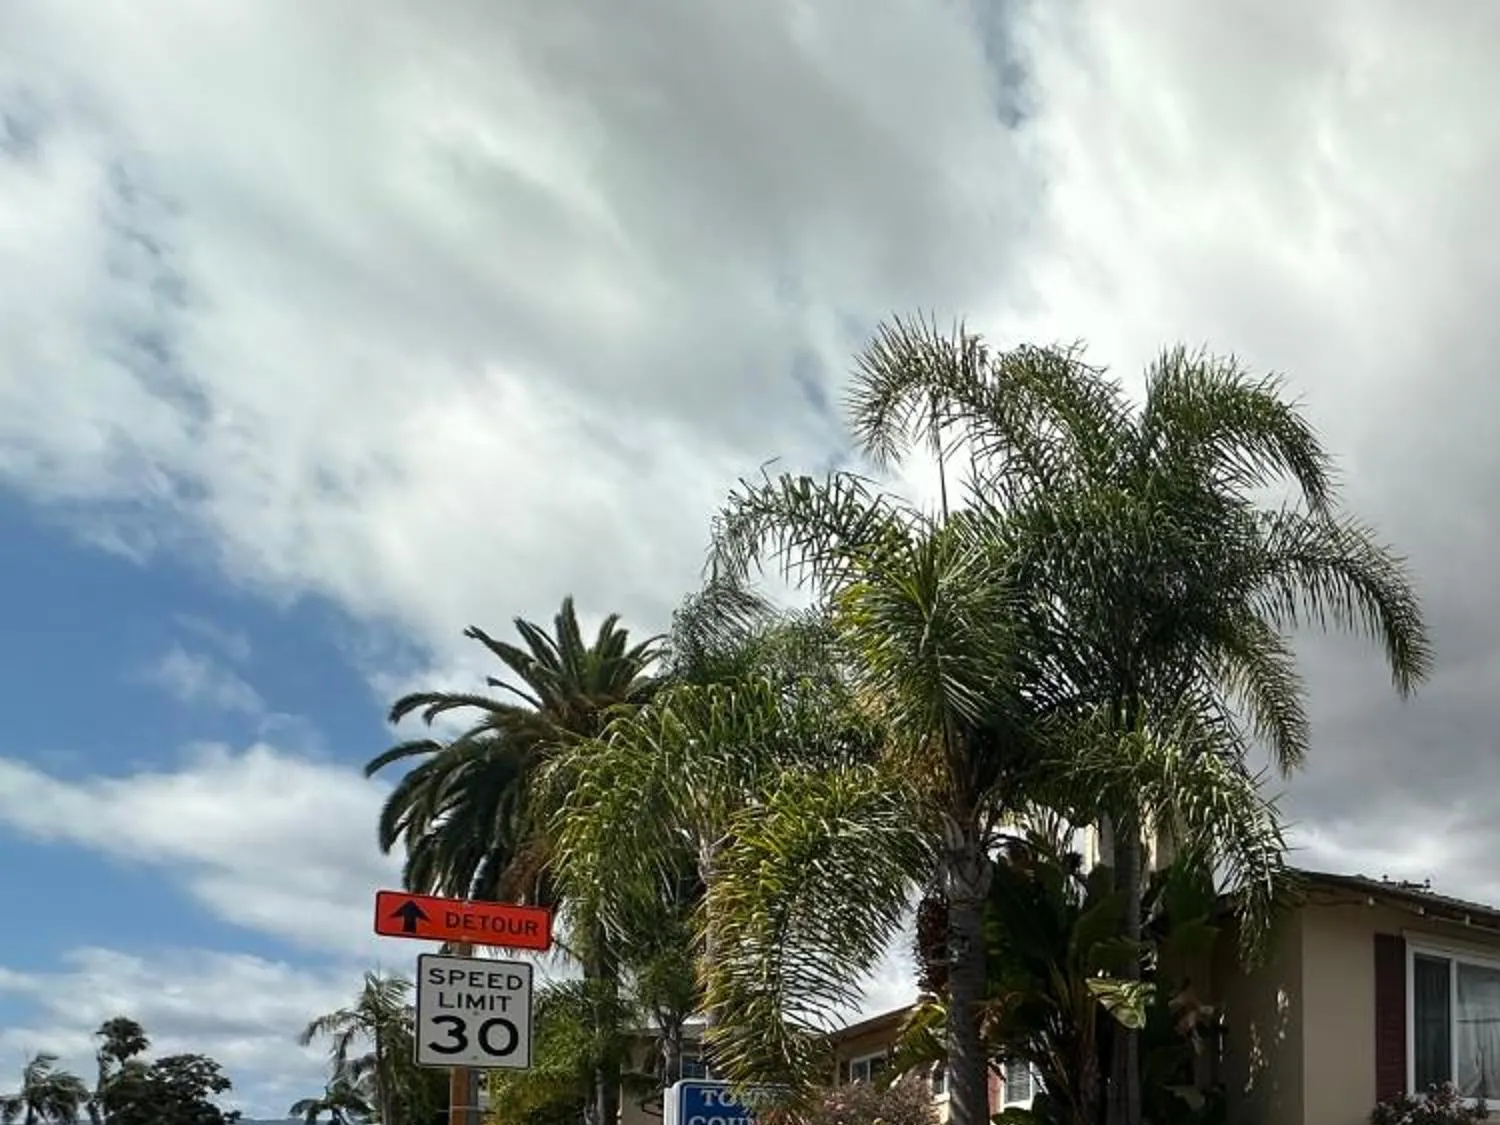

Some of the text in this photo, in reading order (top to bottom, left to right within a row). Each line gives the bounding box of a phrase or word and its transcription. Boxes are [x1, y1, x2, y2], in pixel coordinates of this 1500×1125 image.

[445, 911, 538, 936] DETOUR
[429, 968, 523, 990] SPEED
[439, 993, 511, 1012] LIMIT
[428, 1016, 518, 1056] 30
